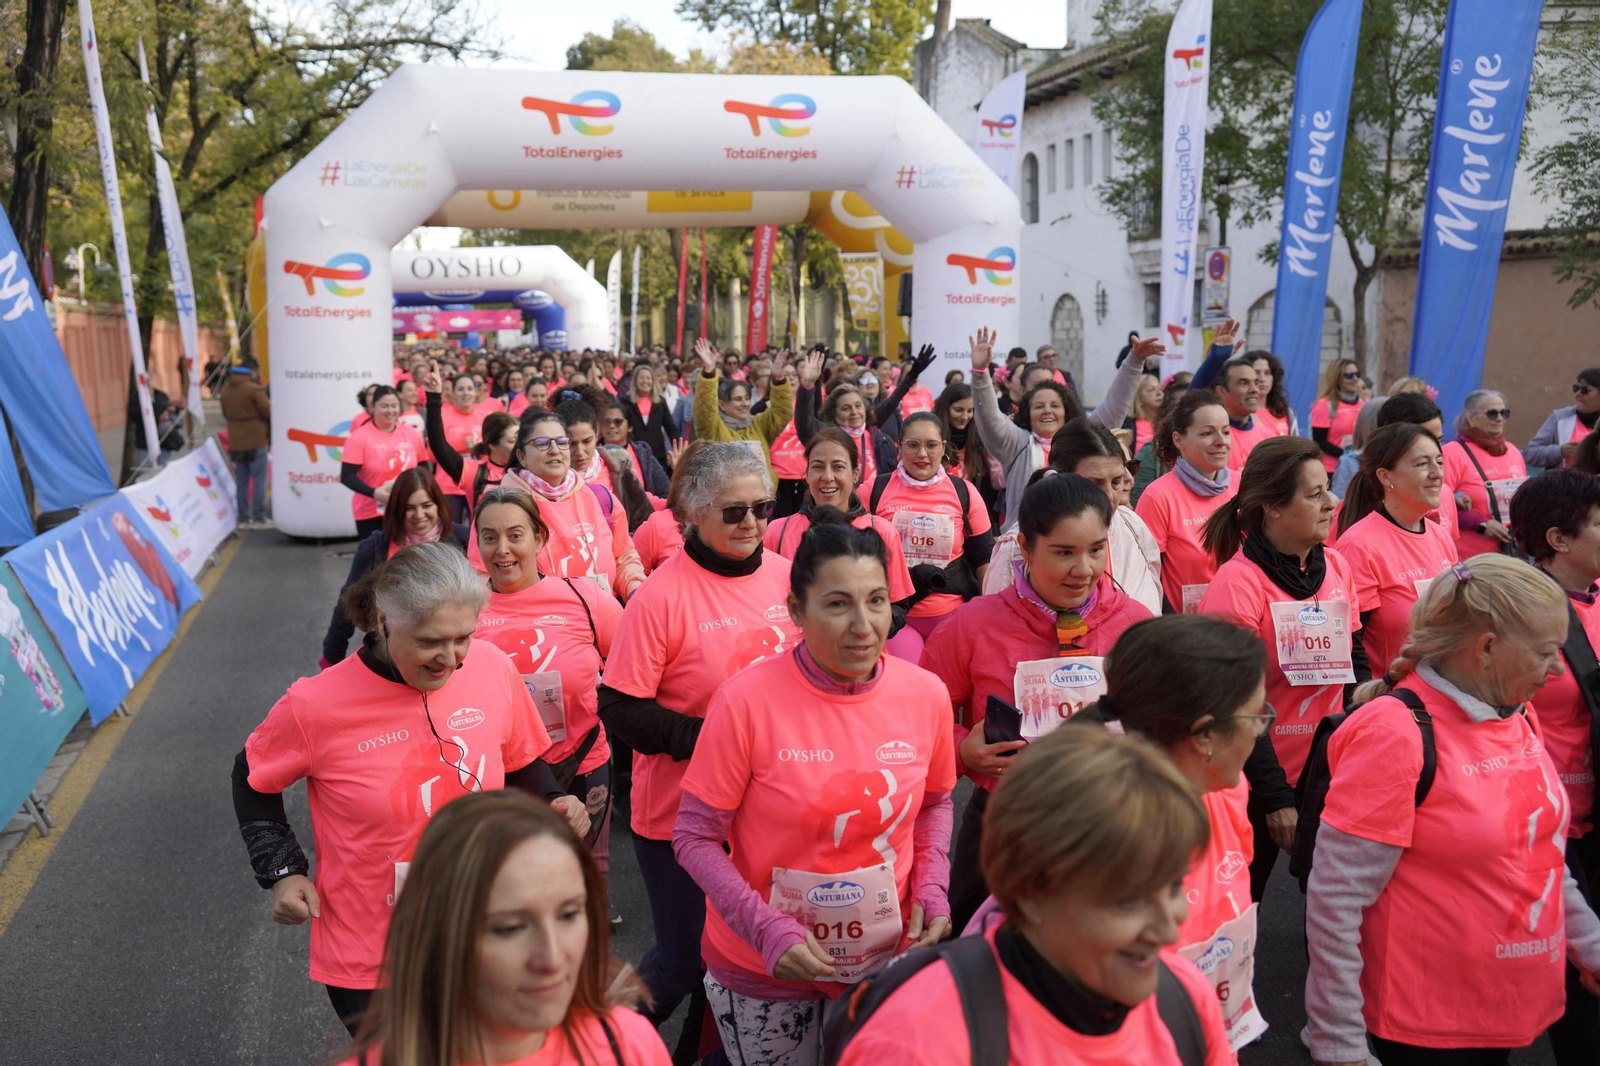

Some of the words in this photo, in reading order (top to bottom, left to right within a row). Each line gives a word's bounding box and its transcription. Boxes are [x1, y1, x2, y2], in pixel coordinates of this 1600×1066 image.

[522, 146, 623, 160] TotalEnergies
[724, 147, 818, 161] TotalEnergies
[1434, 53, 1511, 252] Marlene
[1285, 109, 1336, 278] Marlene
[552, 201, 566, 211] de
[569, 201, 616, 212] Deportes
[411, 255, 522, 281] OYSHO
[753, 224, 773, 299] Santander
[945, 293, 1016, 307] TotalEnergies
[284, 305, 372, 320] TotalEnergies
[284, 369, 373, 381] totalenergies.es
[287, 471, 341, 485] TotalEne
[911, 536, 934, 546] 016
[699, 616, 738, 633] OYSHO
[1305, 636, 1331, 650] 016
[1053, 673, 1098, 683] ASTURIANA
[1288, 673, 1314, 681] OYSHO
[450, 713, 482, 727] ASTURIANA
[1275, 723, 1313, 735] CARRERA
[357, 729, 409, 753] OYSHO
[778, 748, 834, 762] OYSHO
[880, 750, 916, 760] ASTURIANA
[1462, 755, 1509, 777] OYSHO
[782, 890, 804, 901] SUMA
[811, 891, 862, 902] ASTURIANA
[813, 921, 863, 941] 016
[829, 947, 846, 955] 831
[1496, 943, 1549, 960] CARRERA
